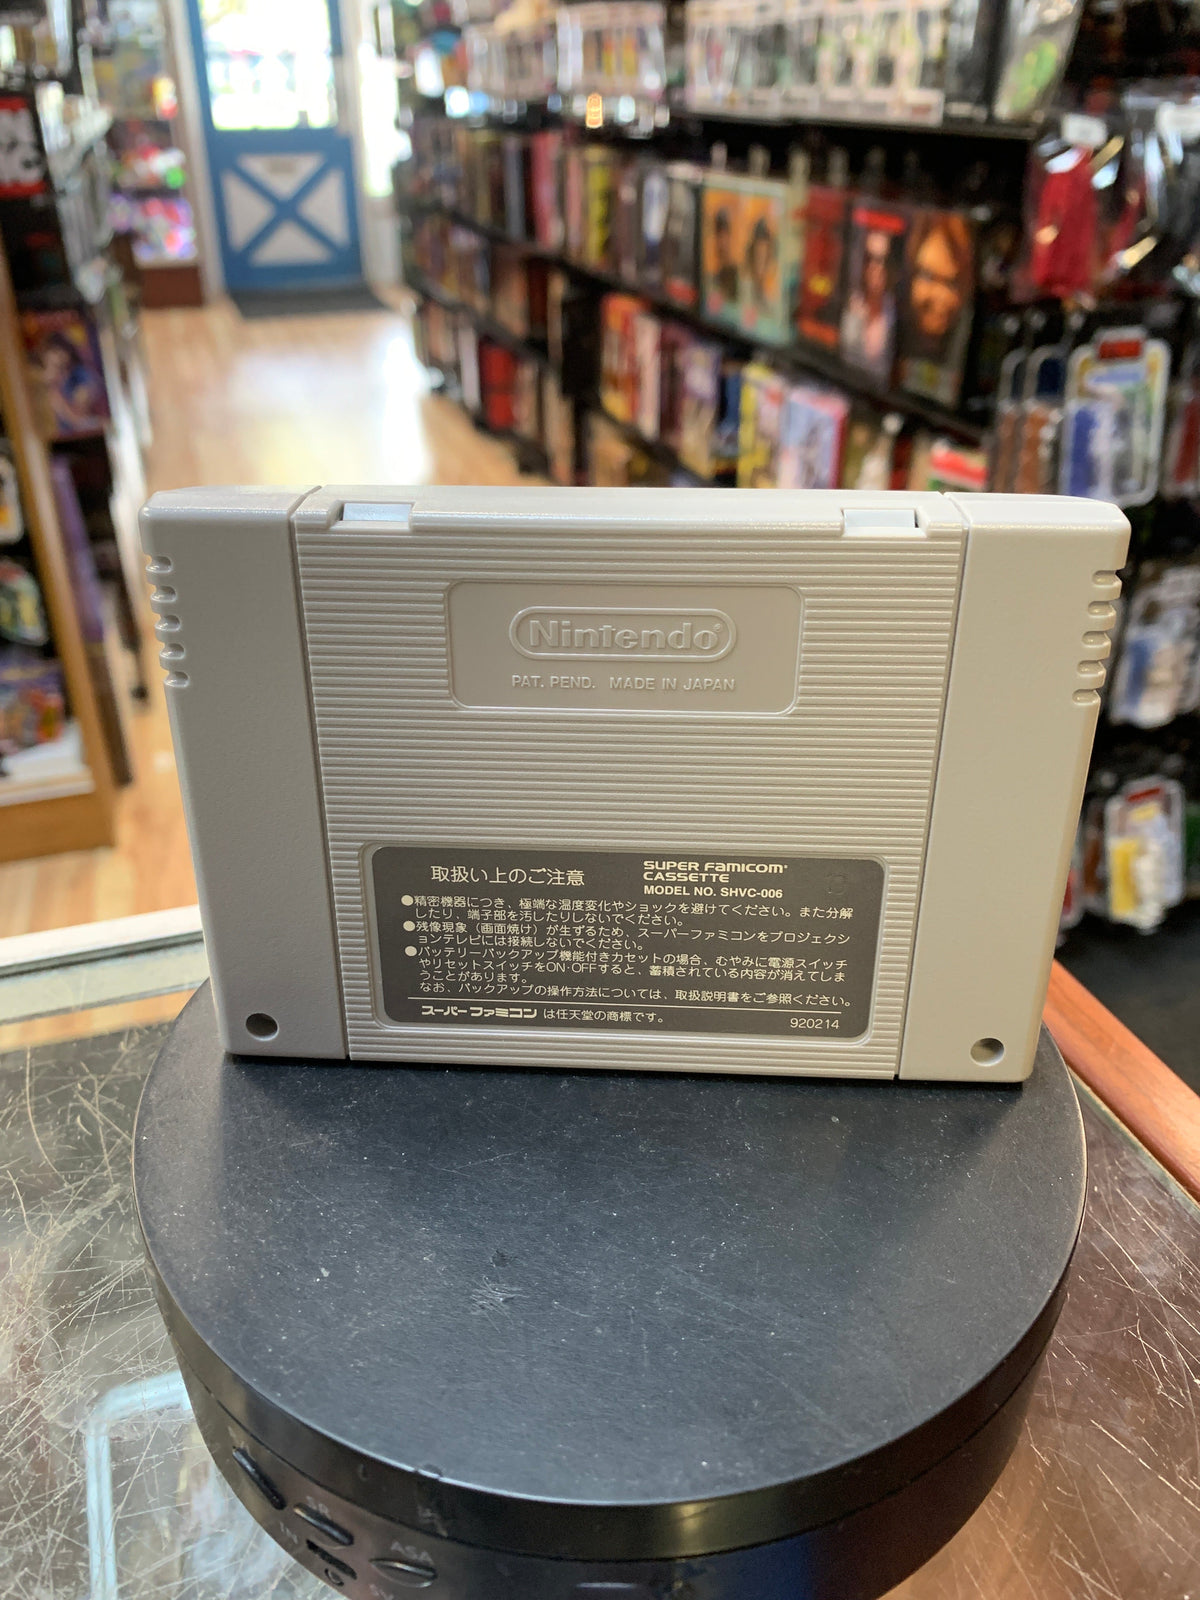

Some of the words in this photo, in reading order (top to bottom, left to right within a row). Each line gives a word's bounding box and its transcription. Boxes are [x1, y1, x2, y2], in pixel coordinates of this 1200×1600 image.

[529, 620, 719, 650] Nintendo
[511, 674, 545, 688] PAT.
[550, 675, 596, 689] PEND.
[609, 677, 656, 690] MADE
[661, 678, 677, 690] IN
[683, 678, 736, 691] JAPAN
[643, 860, 700, 872] SUPER
[430, 865, 585, 886] 取扱い上のご注意
[643, 872, 730, 883] CASSETTE
[643, 885, 690, 896] MODEL
[693, 886, 717, 897] NO.
[720, 886, 783, 899] SHVC-006
[789, 1017, 840, 1030] 920214
